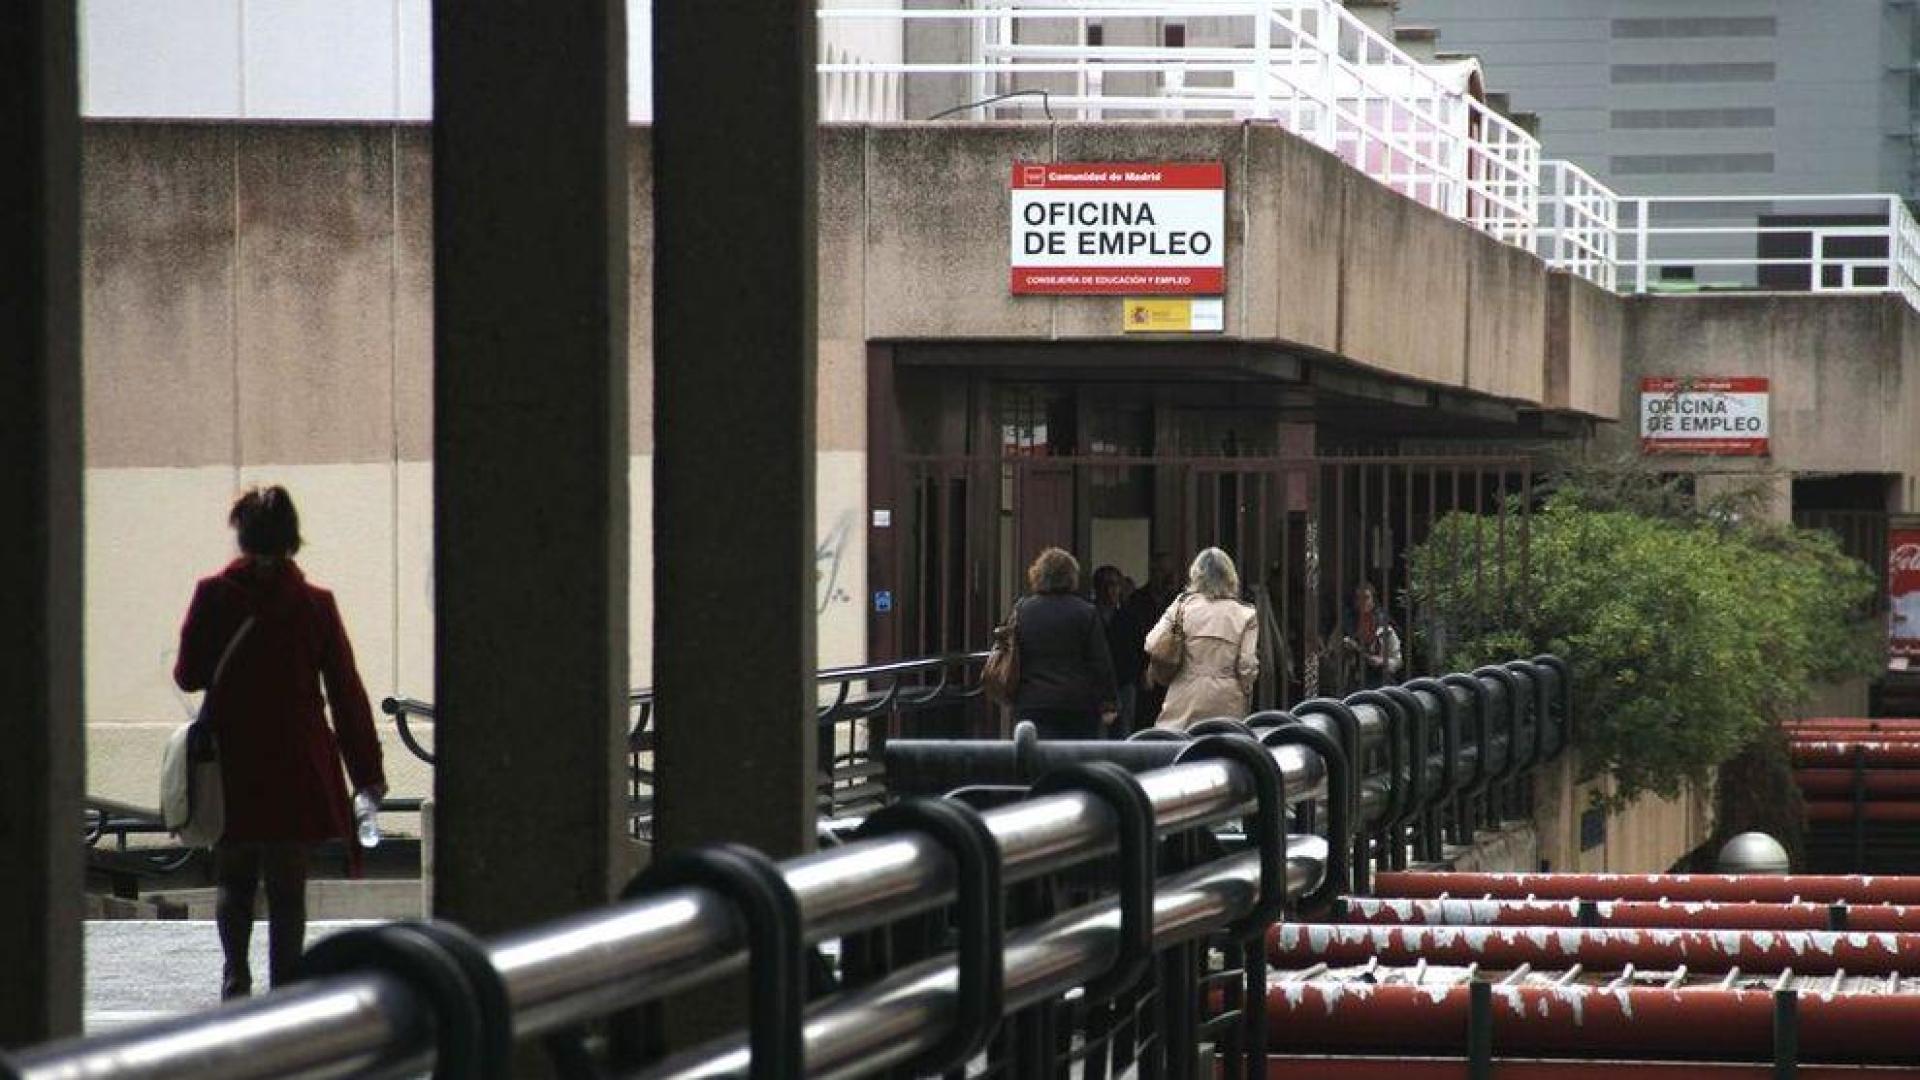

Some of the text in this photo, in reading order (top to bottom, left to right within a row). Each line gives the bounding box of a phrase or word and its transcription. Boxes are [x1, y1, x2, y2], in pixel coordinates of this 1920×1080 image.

[1125, 172, 1161, 181] Madrid
[1023, 201, 1156, 226] OFICINA
[1024, 231, 1212, 255] DE EMPLEO
[1648, 399, 1727, 414] OFICINA
[1648, 416, 1761, 431] DE EMPLEO
